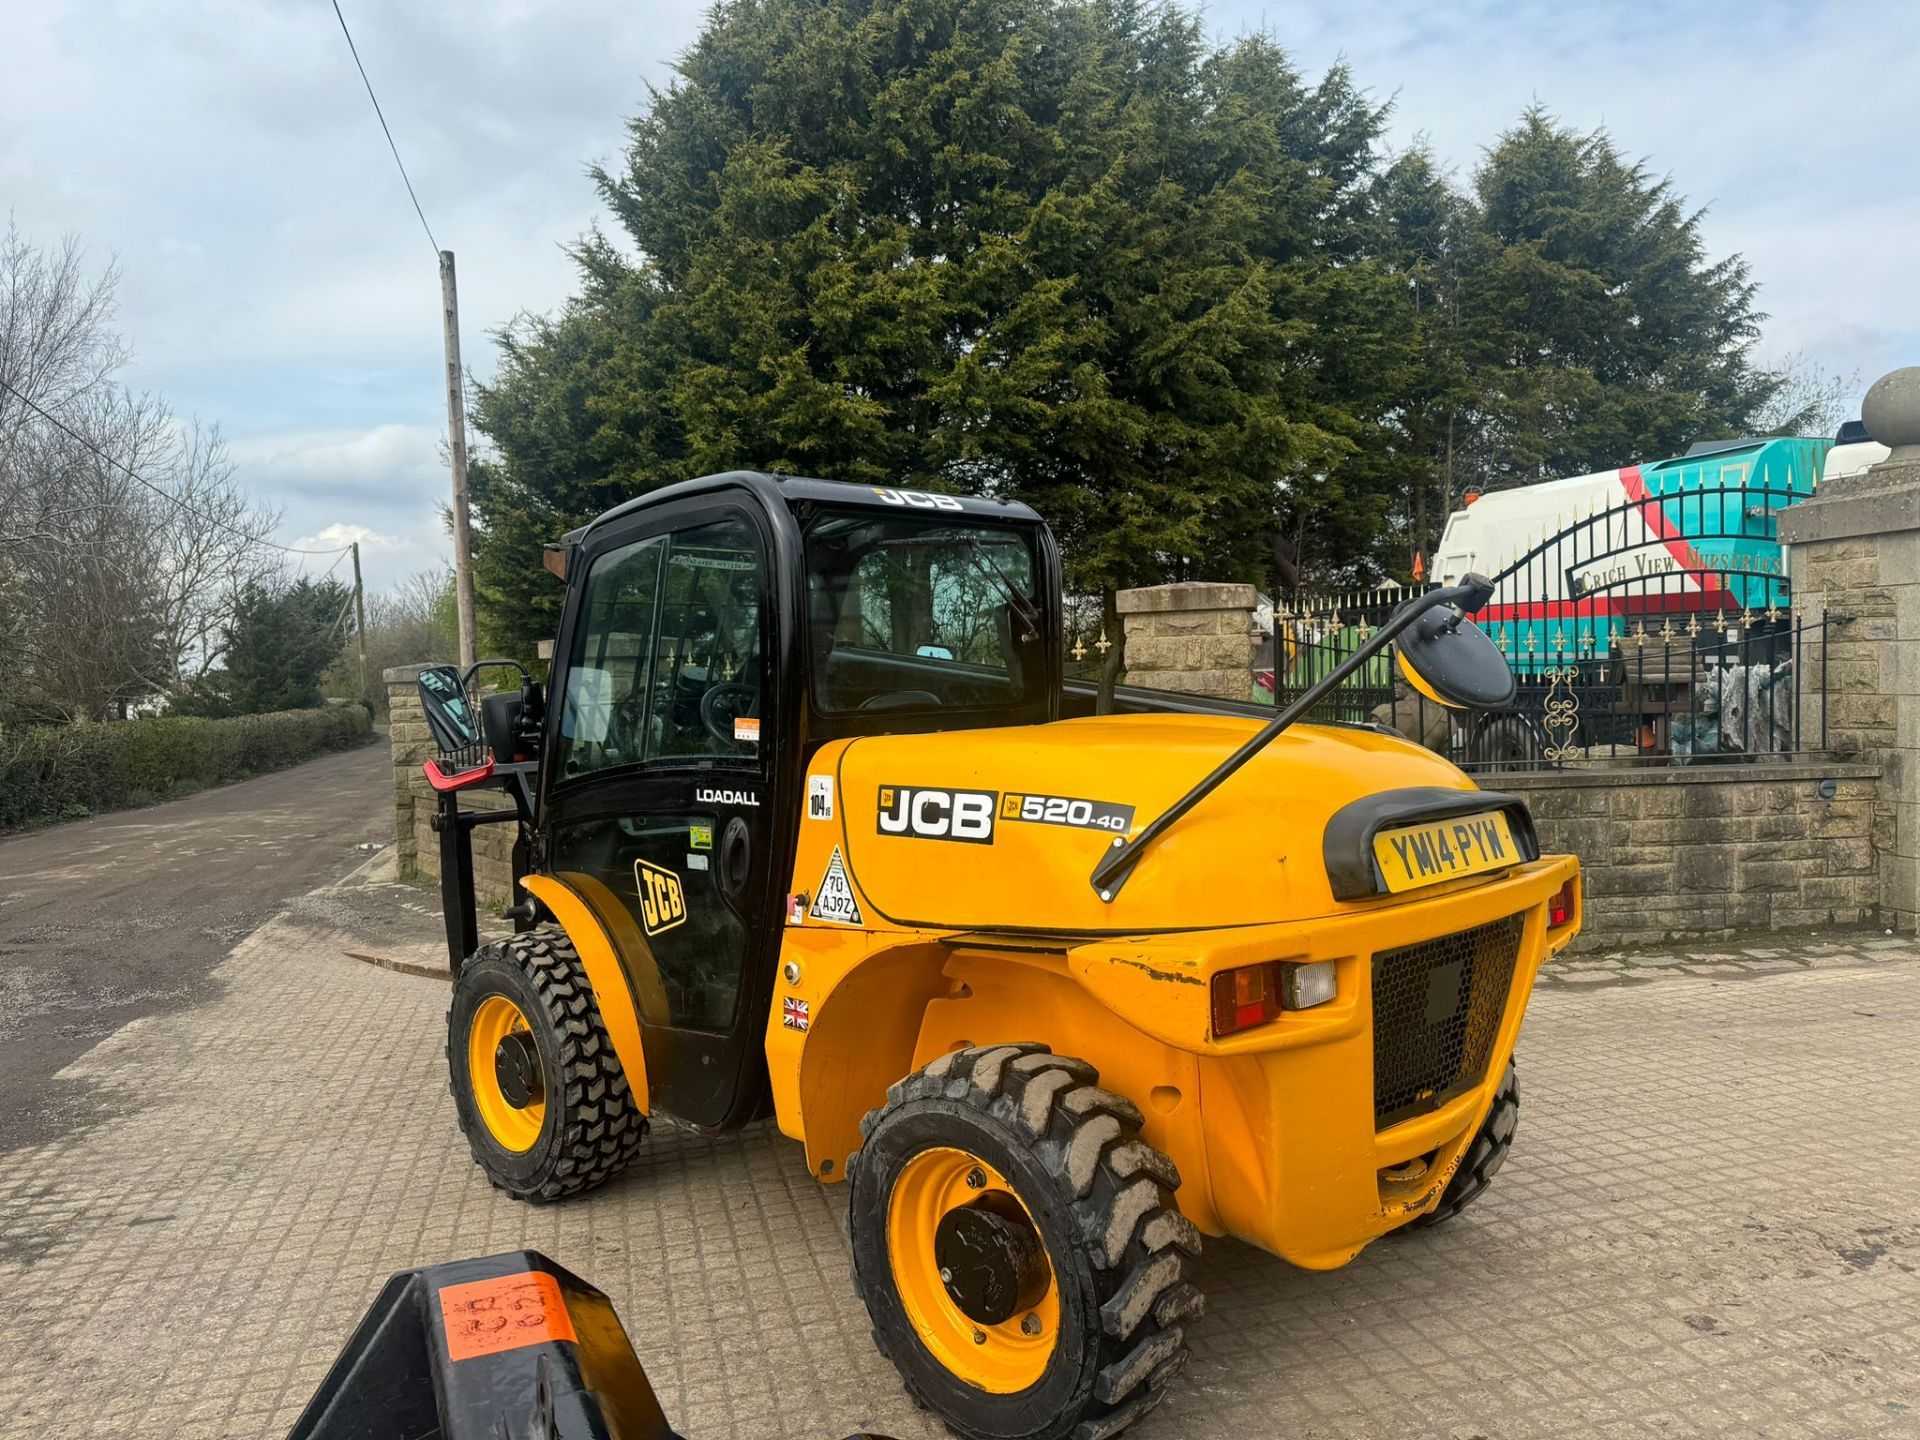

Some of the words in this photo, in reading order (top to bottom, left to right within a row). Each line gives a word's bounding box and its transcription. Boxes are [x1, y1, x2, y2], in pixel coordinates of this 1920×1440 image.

[880, 489, 964, 511] JCB
[1581, 565, 1627, 592] CRICH
[1634, 553, 1676, 577] VIEW
[1685, 546, 1782, 574] NURSERIES
[696, 788, 760, 806] LOADALL
[811, 794, 825, 816] 104
[880, 789, 993, 839] JCB
[1021, 796, 1126, 830] 520-40
[1390, 828, 1456, 880] YM14
[1453, 819, 1505, 867] PYW
[642, 868, 682, 927] JCB
[829, 875, 843, 893] 70
[822, 895, 851, 914] AJ9Z
